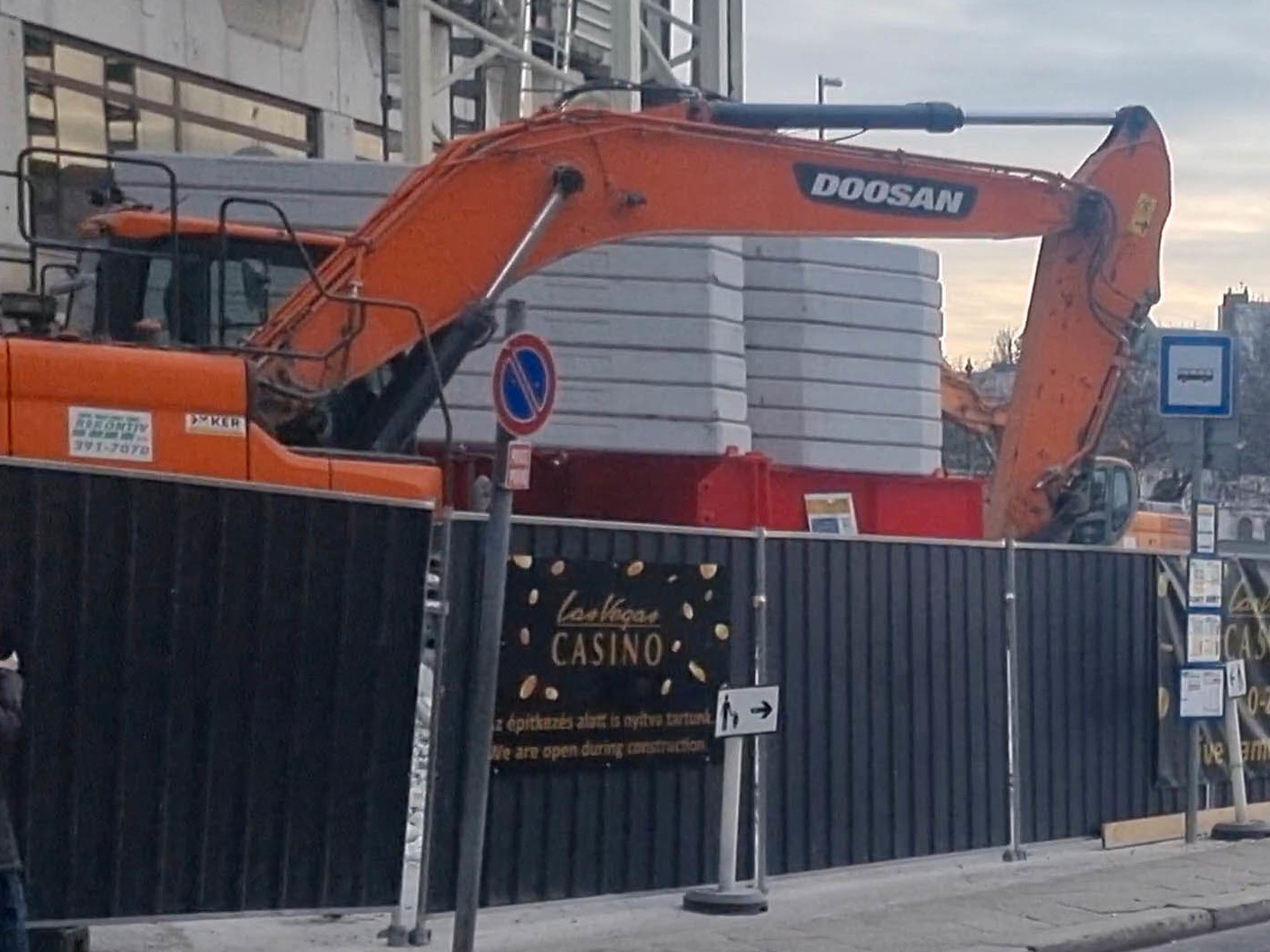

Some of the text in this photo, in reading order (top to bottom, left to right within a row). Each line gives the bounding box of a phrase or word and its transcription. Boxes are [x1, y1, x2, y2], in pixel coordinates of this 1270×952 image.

[811, 173, 963, 213] DOOSAN
[599, 592, 660, 630] Vegas
[552, 631, 663, 667] CASINO
